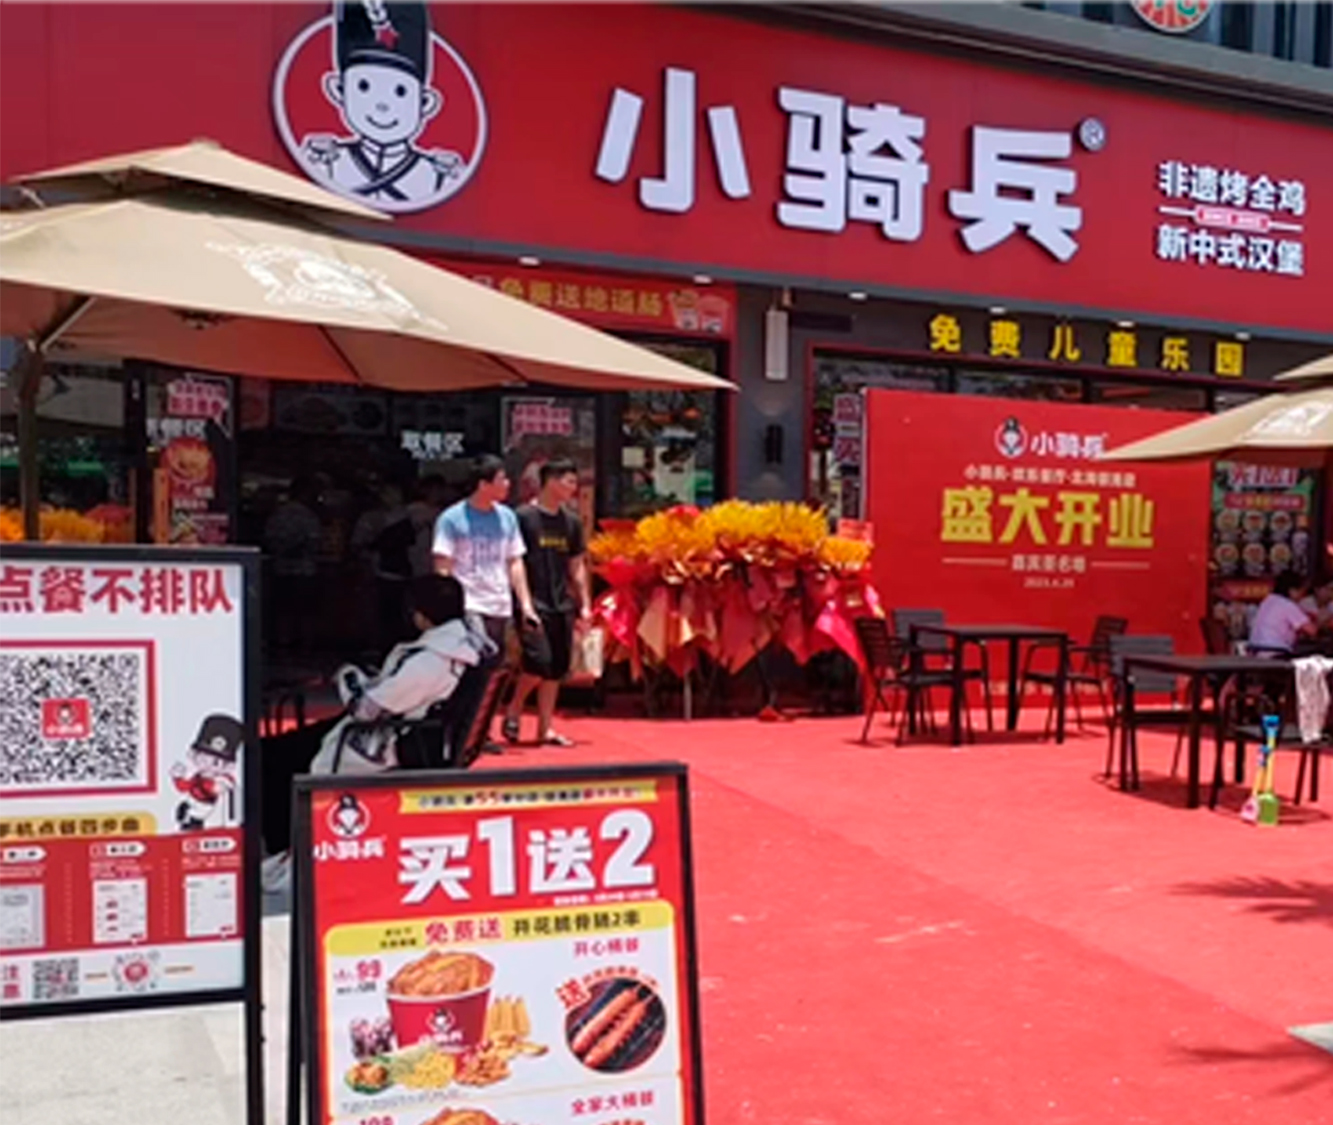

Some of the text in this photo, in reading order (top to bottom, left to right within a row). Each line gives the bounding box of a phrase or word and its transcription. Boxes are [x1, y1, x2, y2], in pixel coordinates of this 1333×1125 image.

[594, 66, 1084, 261] 小骑兵
[1158, 160, 1306, 216] 非遗烤全鸡
[1157, 223, 1305, 277] 新中式汉堡
[930, 313, 1247, 376] 免费儿童乐园
[940, 484, 1154, 549] 盛大开业
[0, 566, 233, 615] 点餐不排队
[397, 808, 656, 905] 买1送2
[425, 917, 502, 946] 免费送
